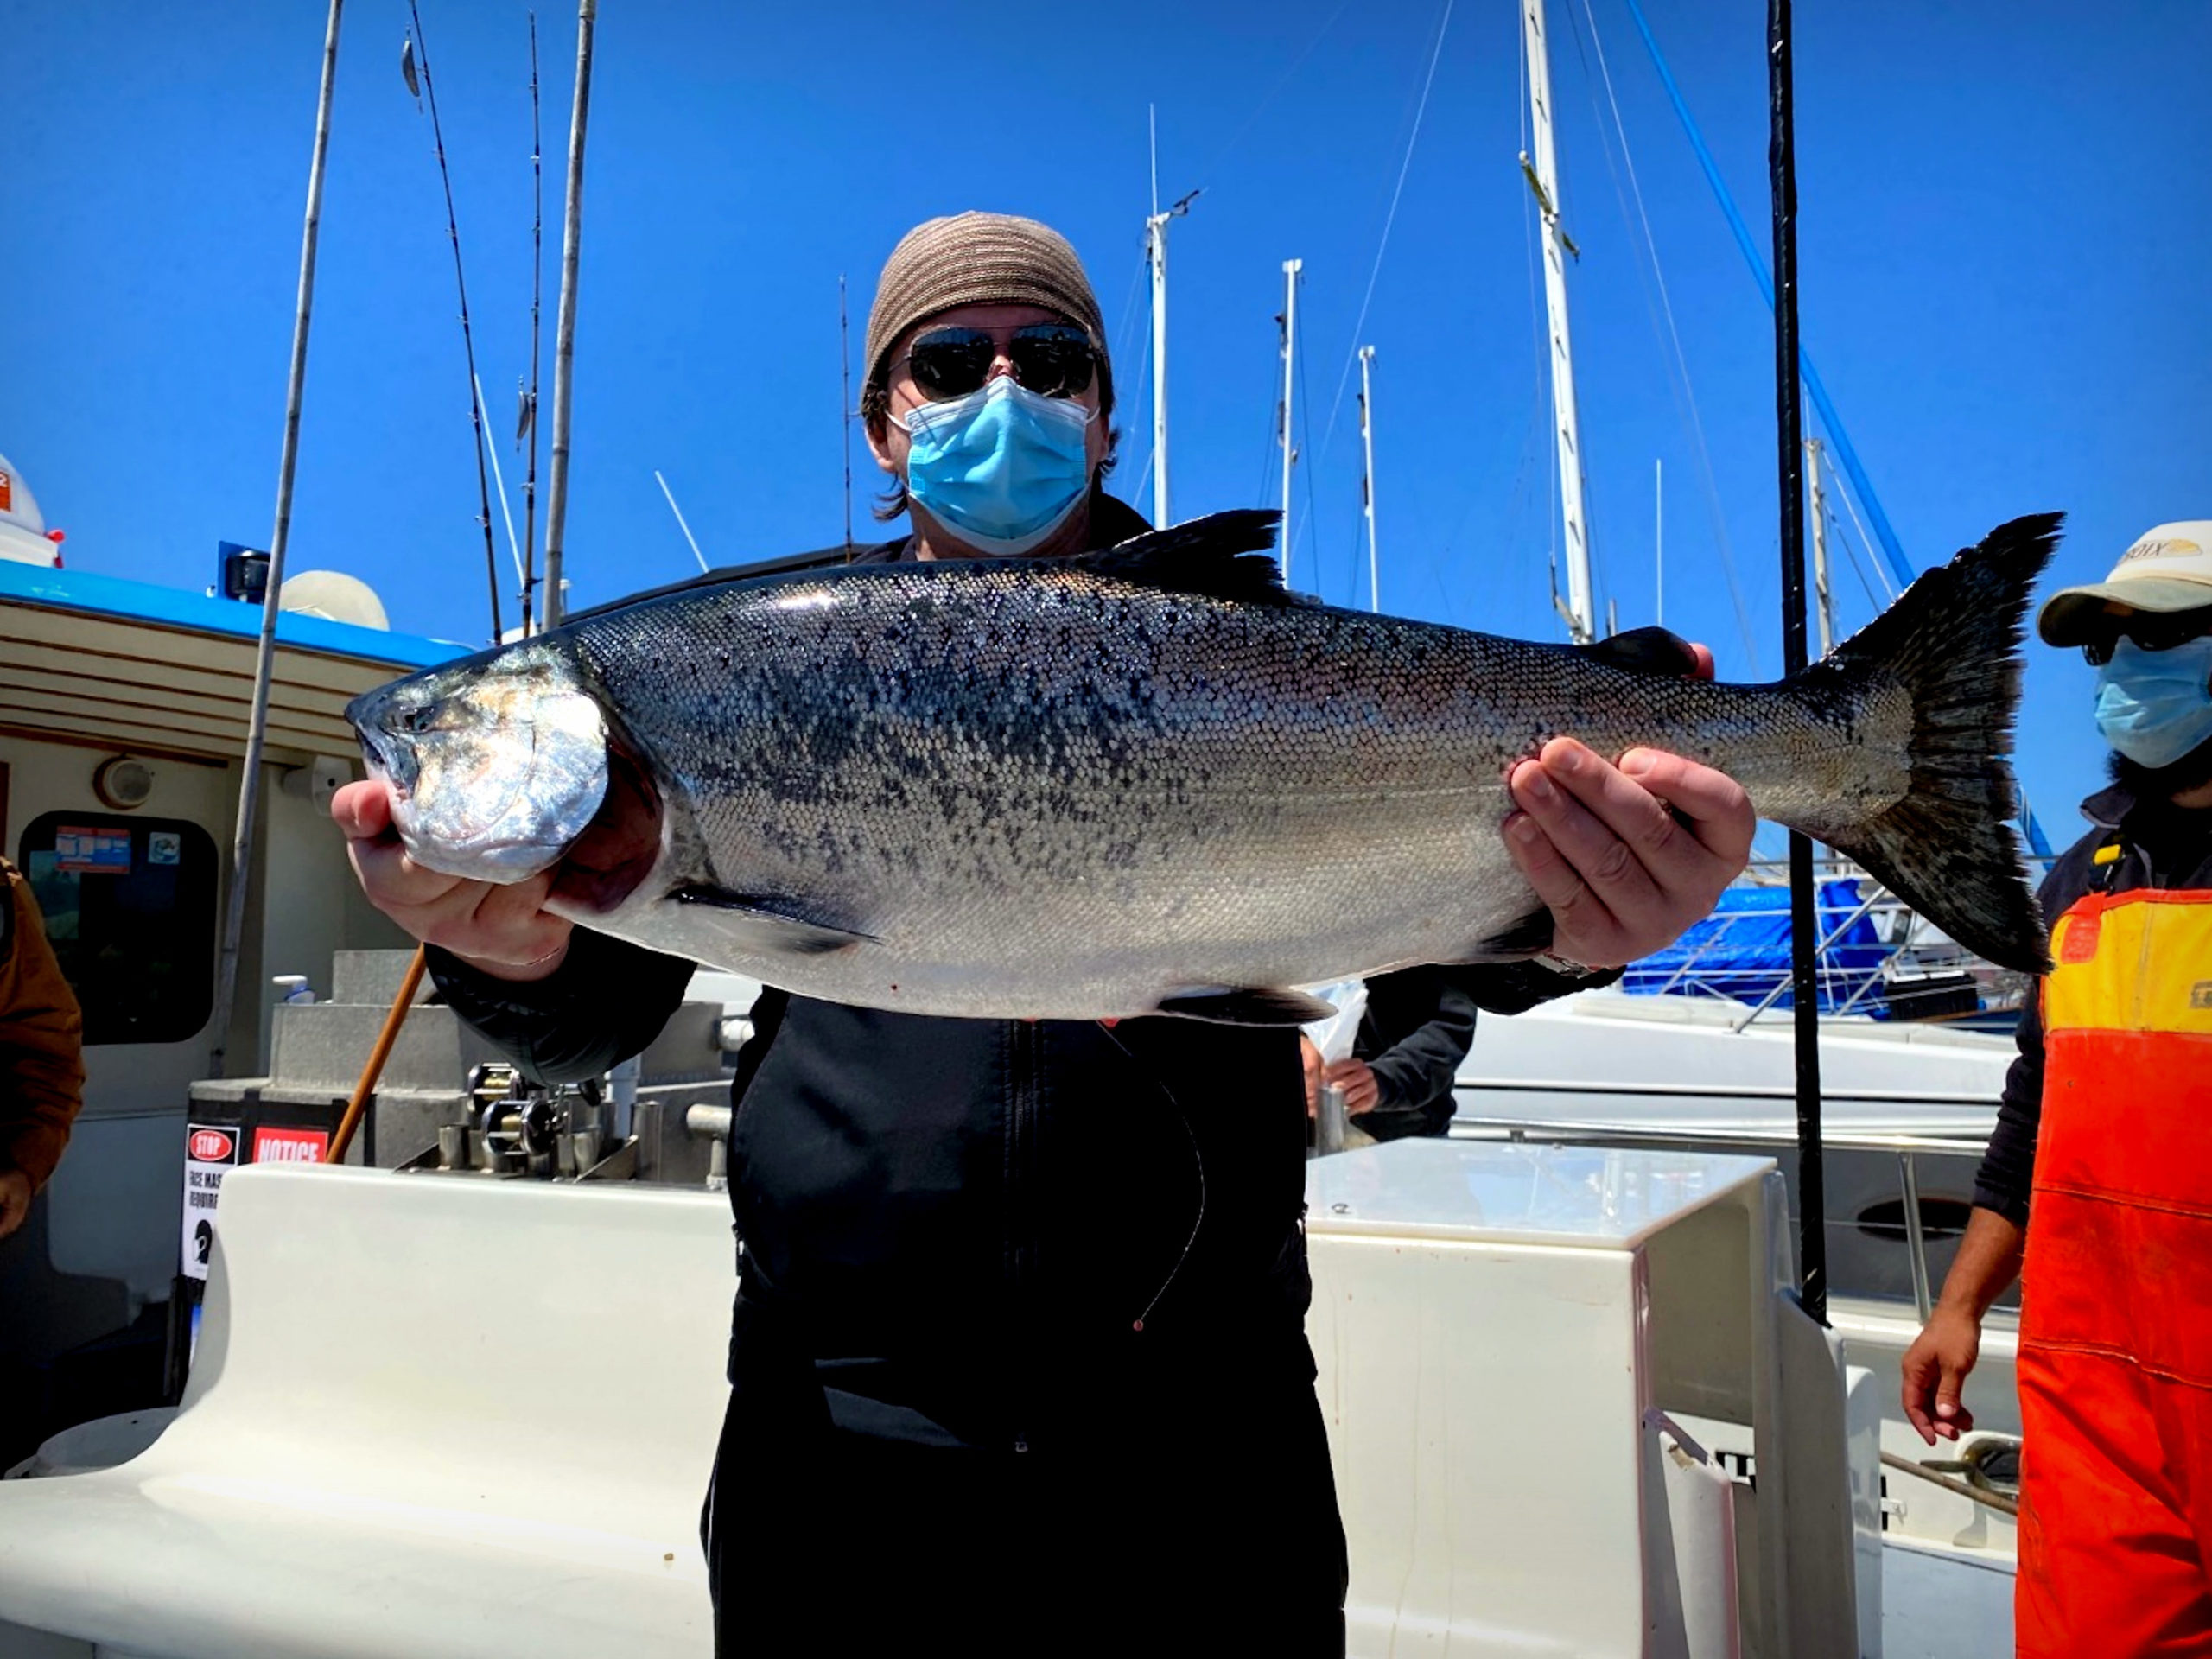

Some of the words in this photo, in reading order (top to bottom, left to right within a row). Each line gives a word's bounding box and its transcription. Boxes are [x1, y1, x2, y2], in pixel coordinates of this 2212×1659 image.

[196, 1135, 221, 1155] STOP
[259, 1139, 319, 1164] NOTICE
[205, 1173, 222, 1189] MAS
